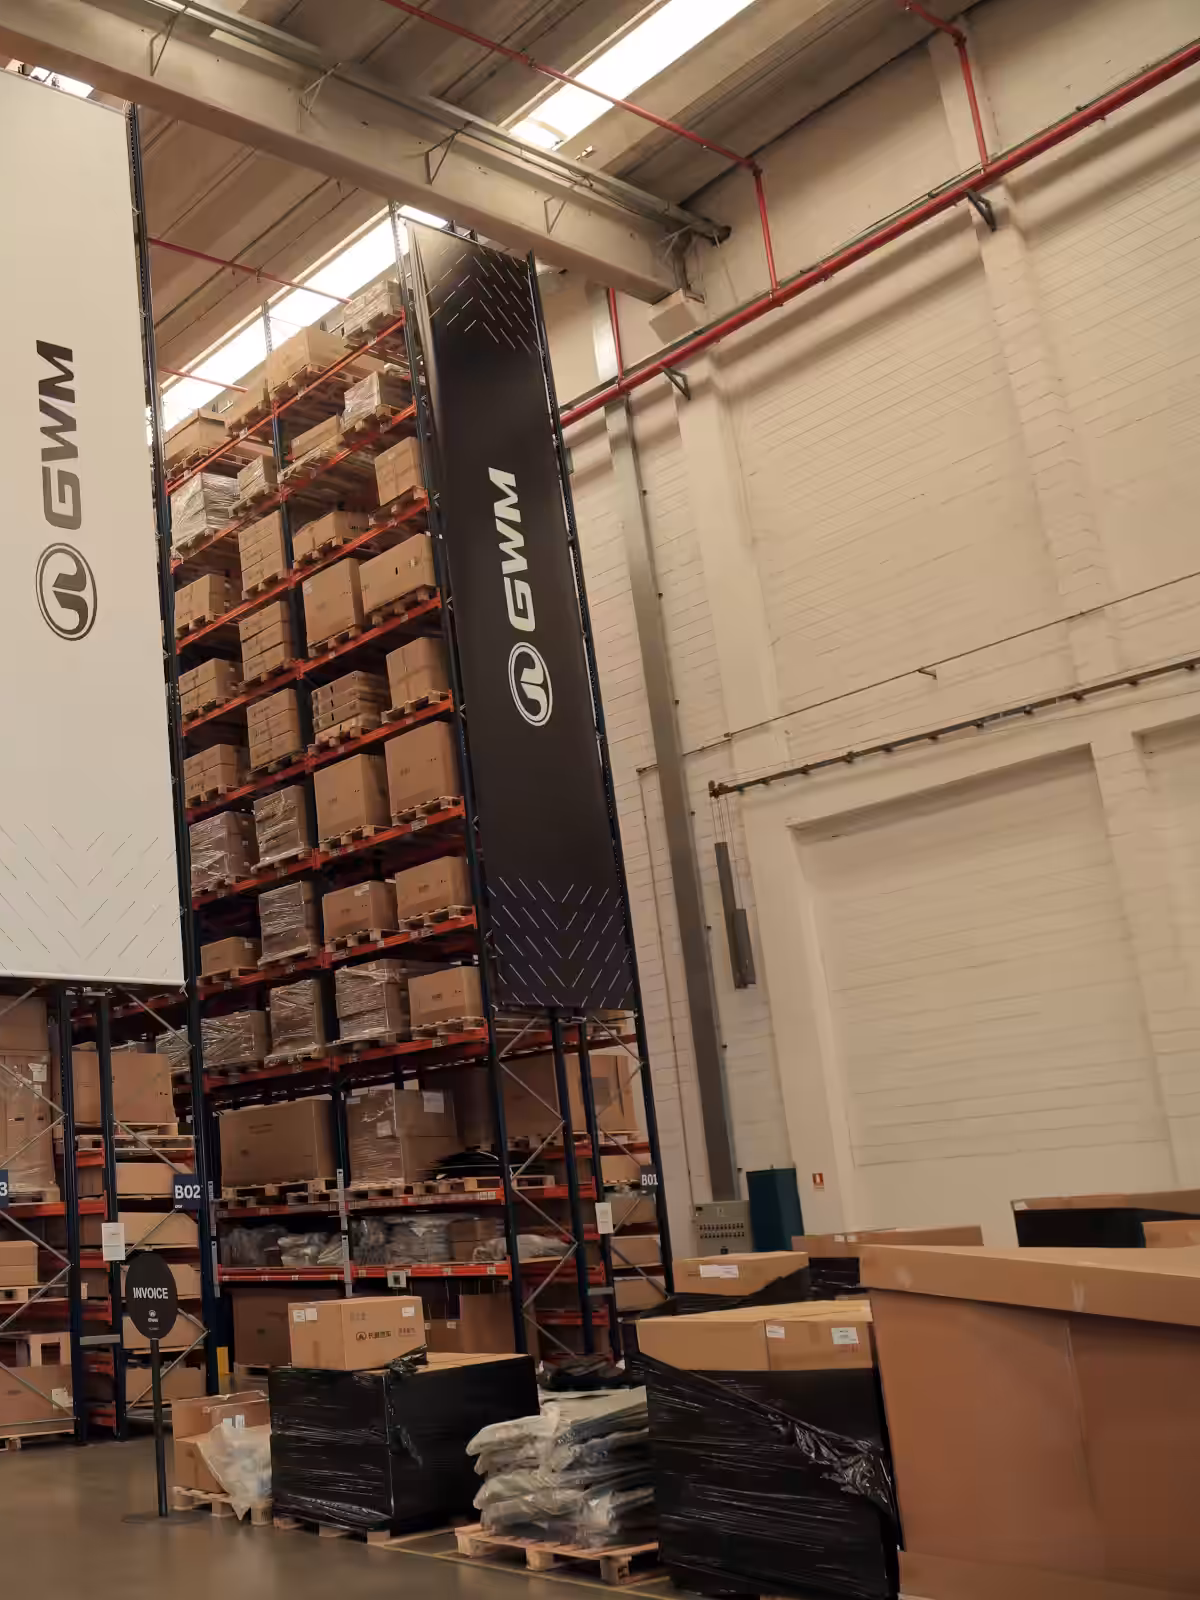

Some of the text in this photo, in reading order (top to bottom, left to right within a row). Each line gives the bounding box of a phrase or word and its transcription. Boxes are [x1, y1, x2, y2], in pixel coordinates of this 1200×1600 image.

[36, 339, 82, 531] GWM
[488, 466, 536, 632] GWM
[641, 1173, 659, 1186] B01
[174, 1184, 201, 1199] B02
[132, 1286, 169, 1300] INVOICE
